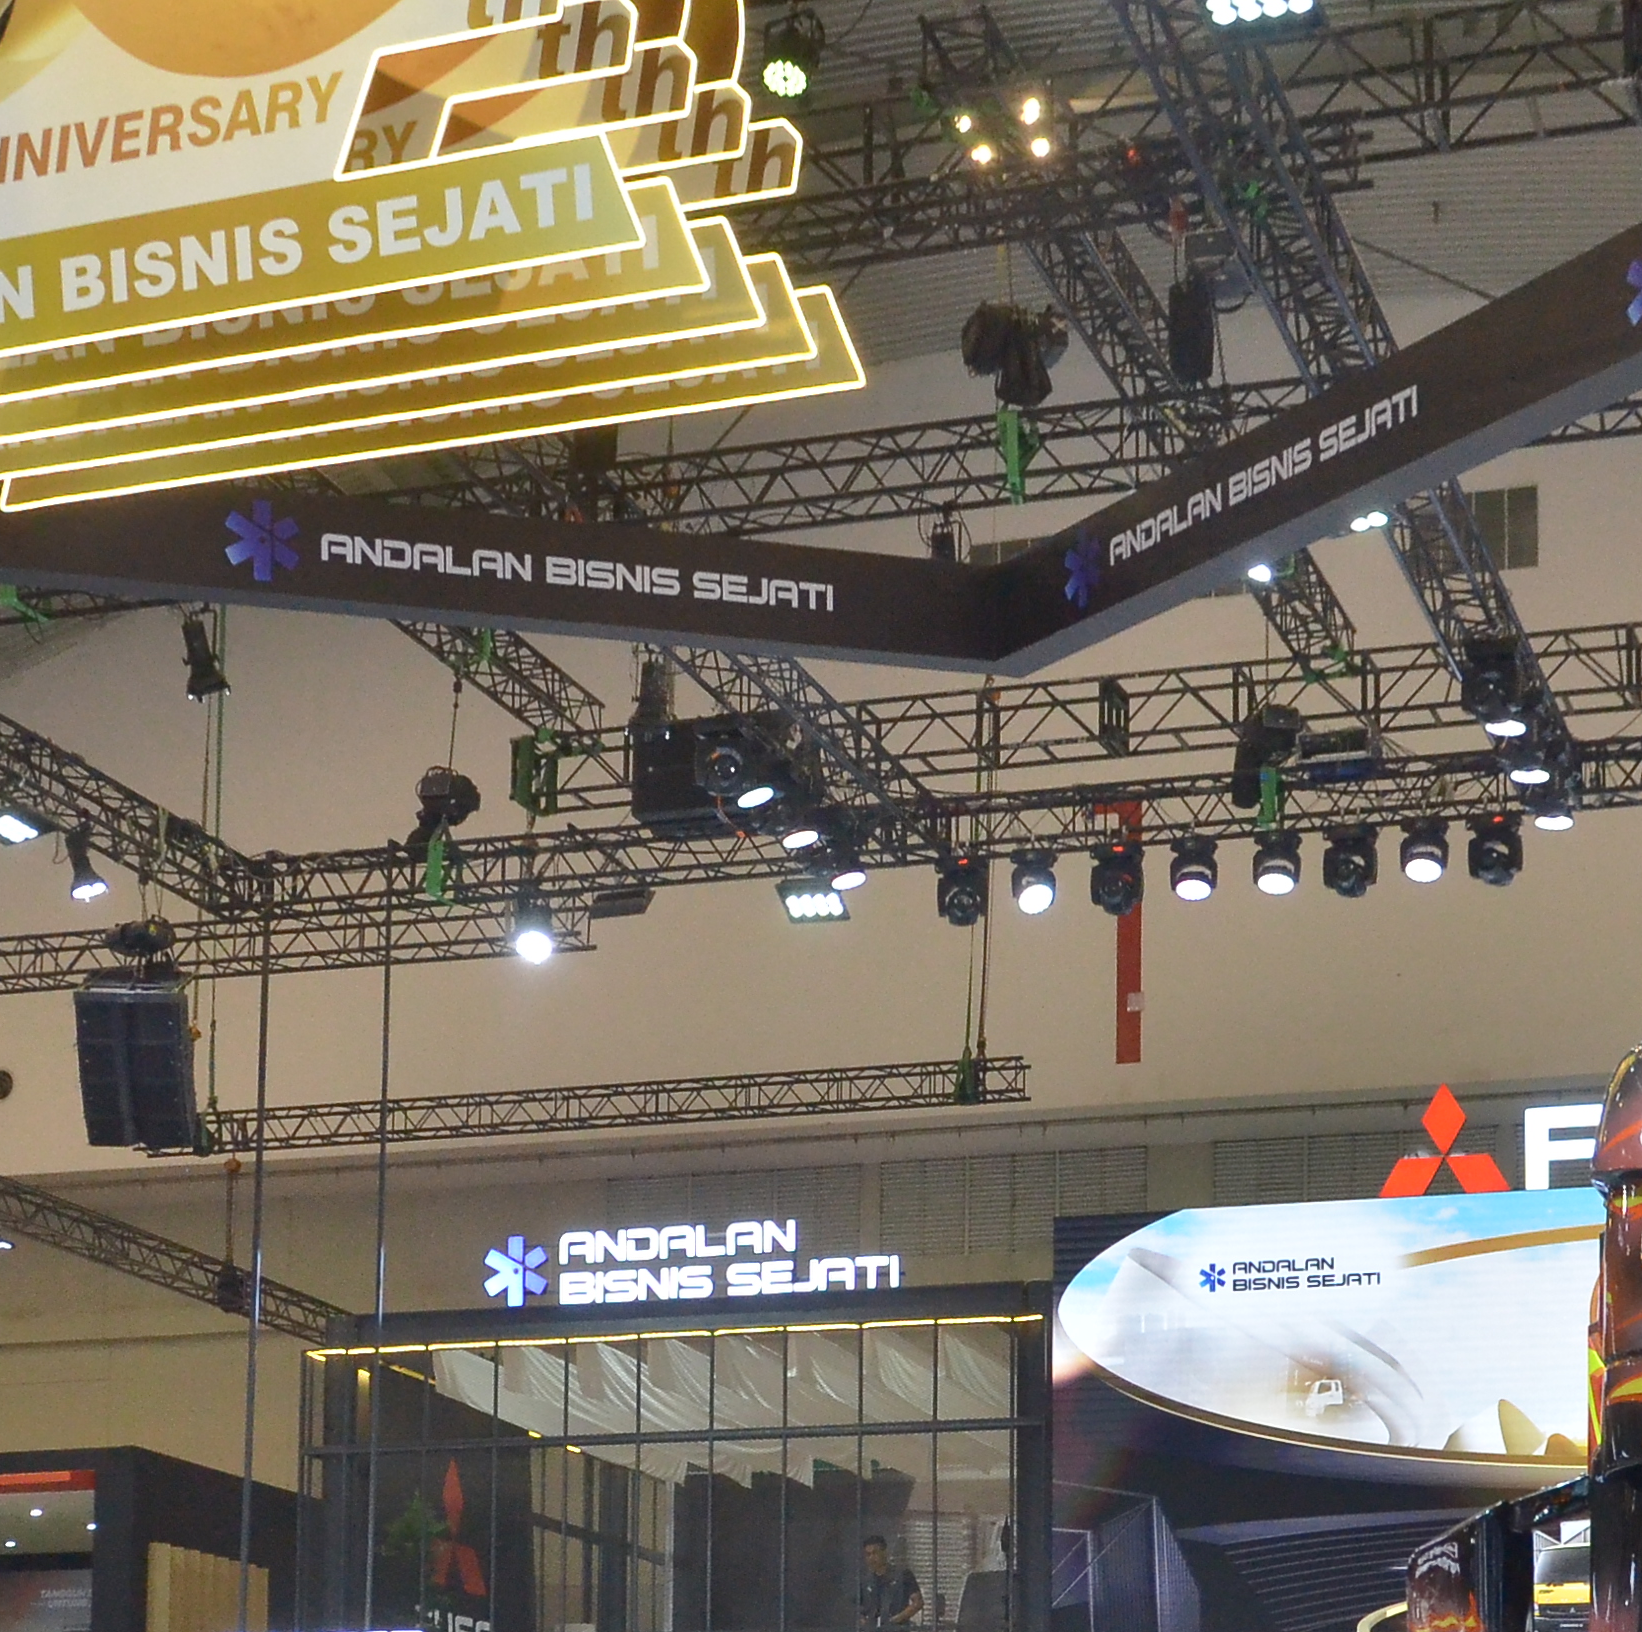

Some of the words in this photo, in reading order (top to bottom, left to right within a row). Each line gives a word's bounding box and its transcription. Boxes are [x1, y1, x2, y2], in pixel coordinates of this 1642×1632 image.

[60, 216, 304, 313] BISNIS
[327, 163, 595, 265] SEJATI
[1109, 471, 1224, 567] ANDALAN
[1228, 433, 1313, 510] BISNIS
[1318, 384, 1419, 467] SEJATI
[320, 532, 535, 583] ANDALAN
[545, 555, 682, 599] BISNIS
[692, 570, 836, 613] SEJATI
[557, 1218, 797, 1266] ANDALAN
[1232, 1257, 1335, 1275] ANDALAN
[558, 1264, 715, 1306] BISNIS
[725, 1254, 902, 1296] SEJATI
[1232, 1276, 1300, 1292] BISNIS
[1306, 1272, 1382, 1288] SEJATI
